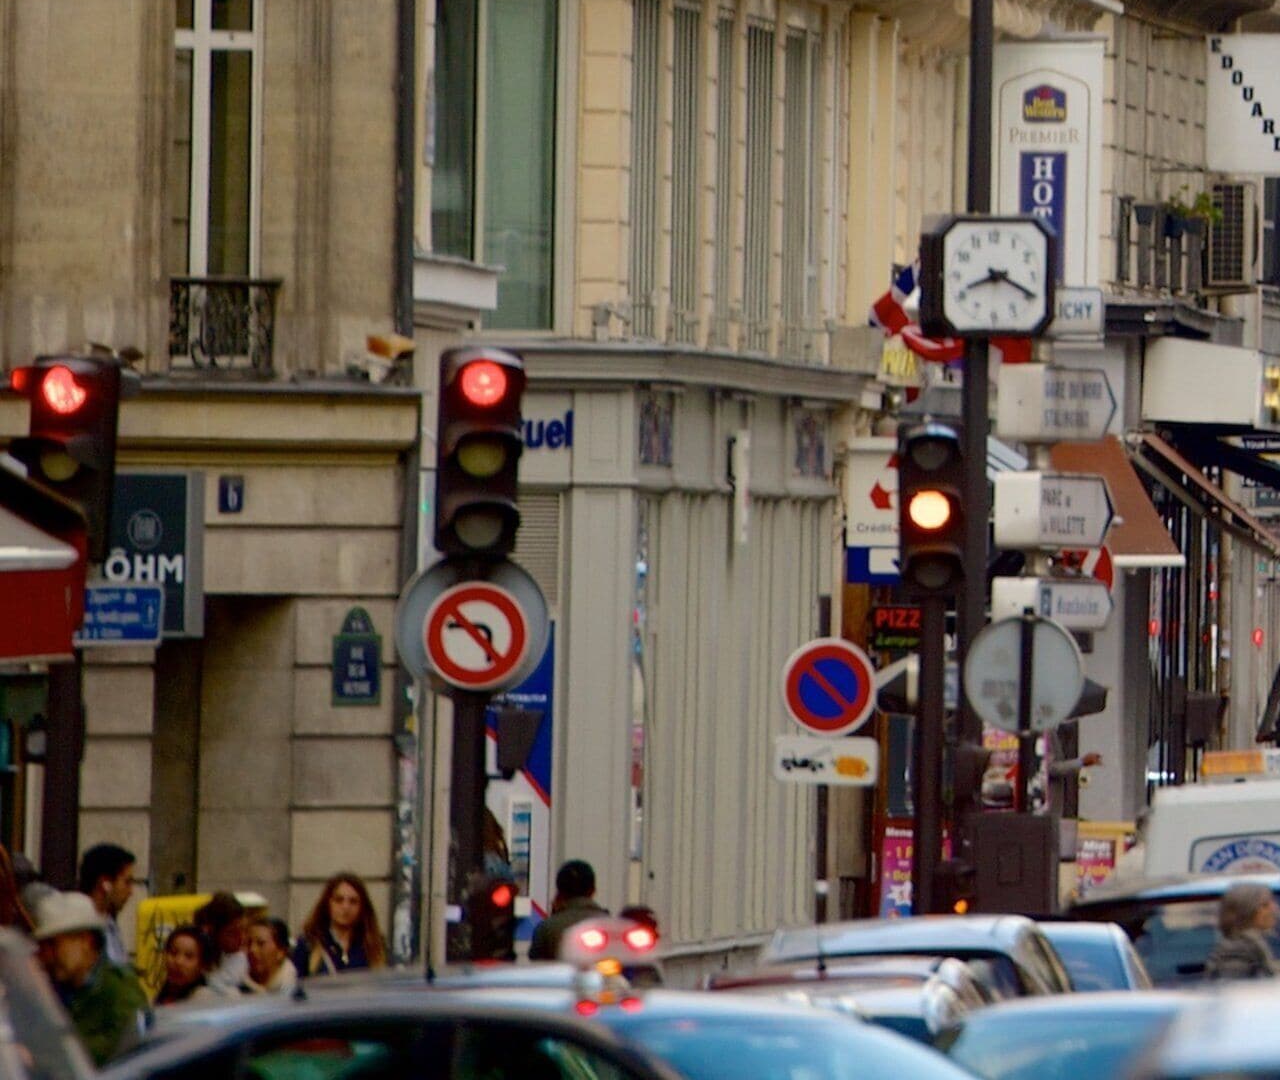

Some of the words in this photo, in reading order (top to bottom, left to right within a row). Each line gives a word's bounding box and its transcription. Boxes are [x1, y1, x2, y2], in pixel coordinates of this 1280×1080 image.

[1058, 302, 1094, 319] ICHY
[526, 409, 574, 449] uel
[875, 609, 921, 629] PIZZ
